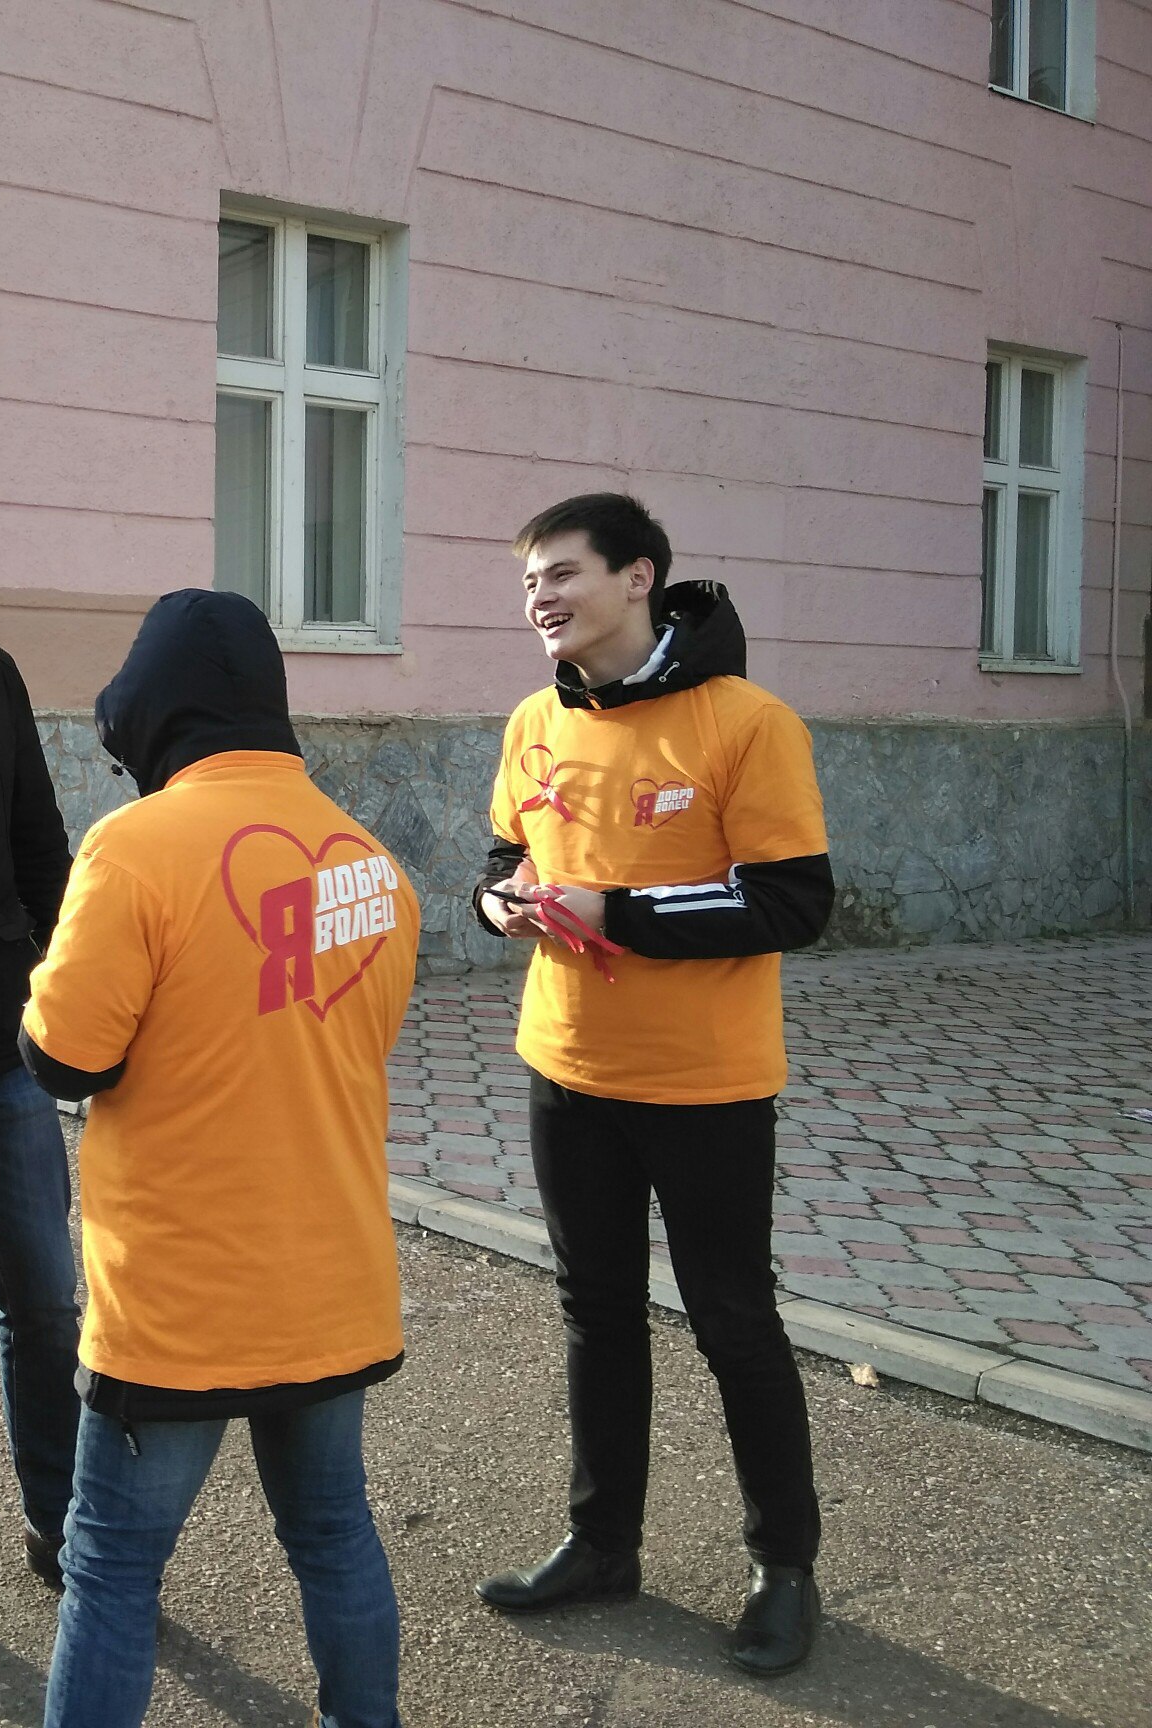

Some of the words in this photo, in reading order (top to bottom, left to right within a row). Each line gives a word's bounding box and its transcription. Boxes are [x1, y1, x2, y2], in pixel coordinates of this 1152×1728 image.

[634, 793, 656, 827] Я
[656, 787, 695, 804] ДОБРО
[654, 799, 689, 814] ВОЛЕЦ
[258, 876, 315, 1016] Я
[315, 855, 398, 914] ДОБРО
[314, 894, 396, 955] ВОЛЕЦ
